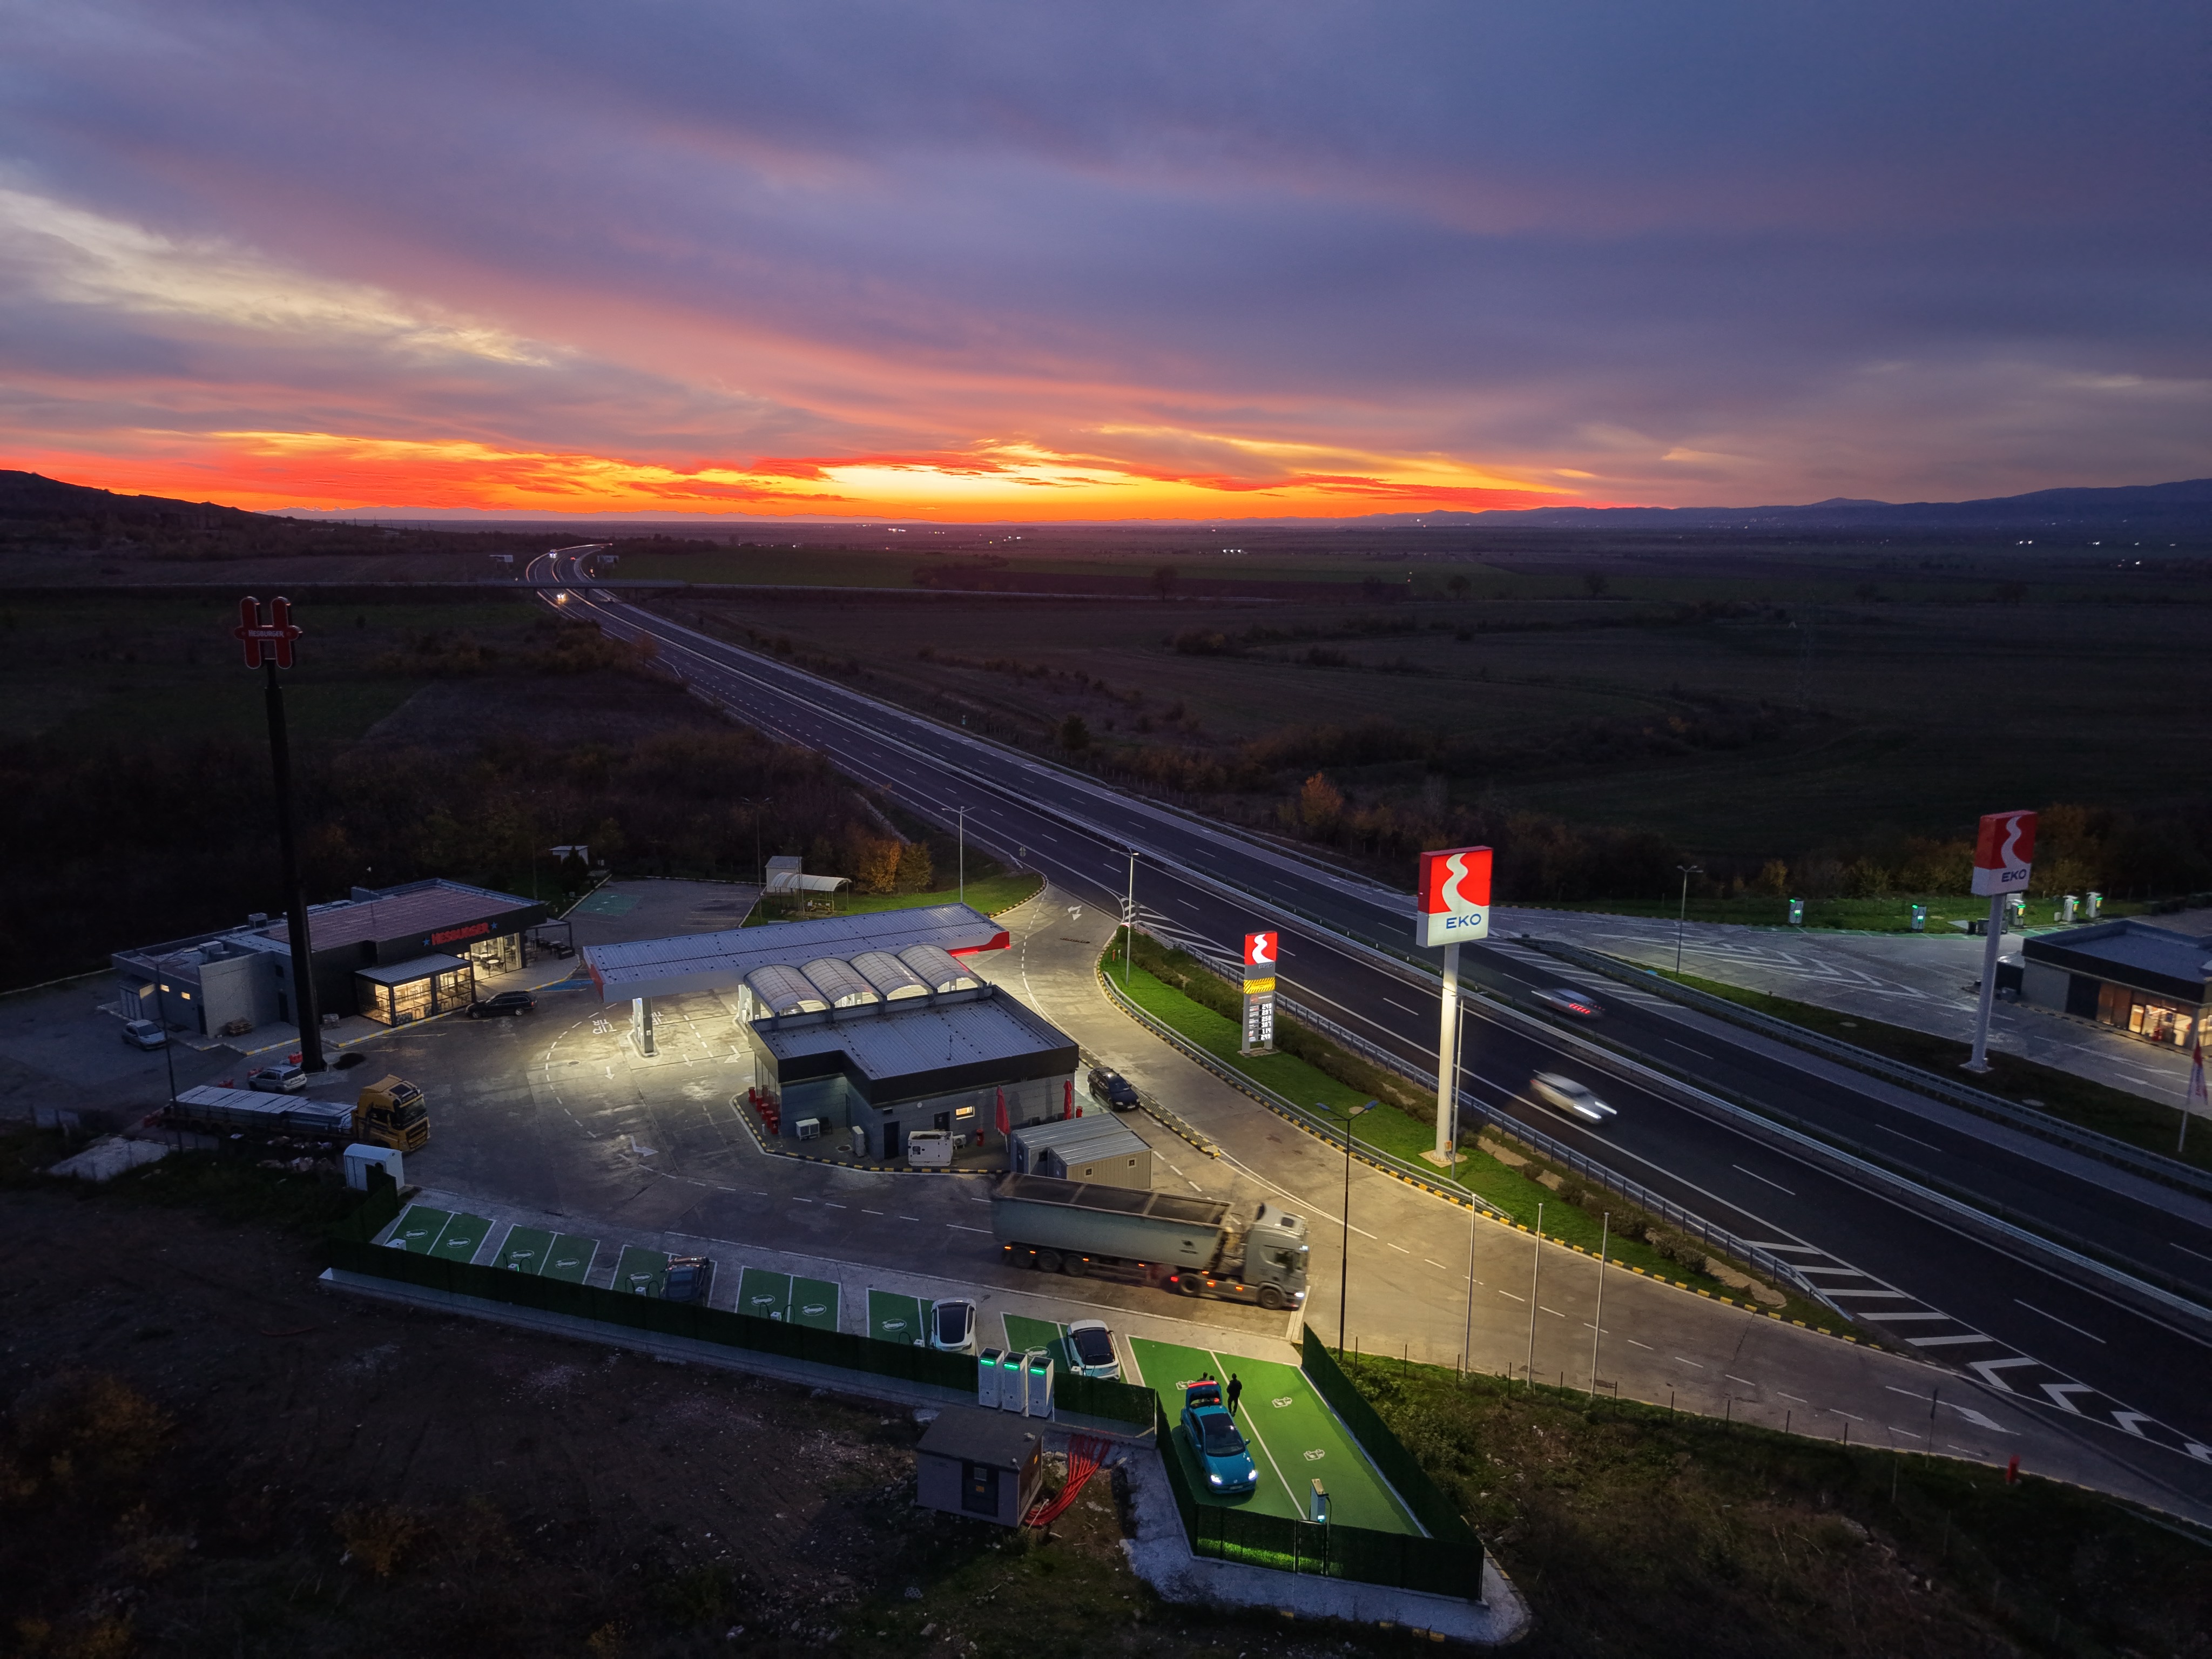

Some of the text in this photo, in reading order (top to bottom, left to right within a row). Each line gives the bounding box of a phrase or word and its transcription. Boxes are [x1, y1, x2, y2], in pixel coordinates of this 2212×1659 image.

[248, 630, 285, 638] HESBURGER
[2001, 868, 2027, 882] EKO
[1446, 913, 1481, 929] EKO
[431, 922, 490, 946] HESBURGER
